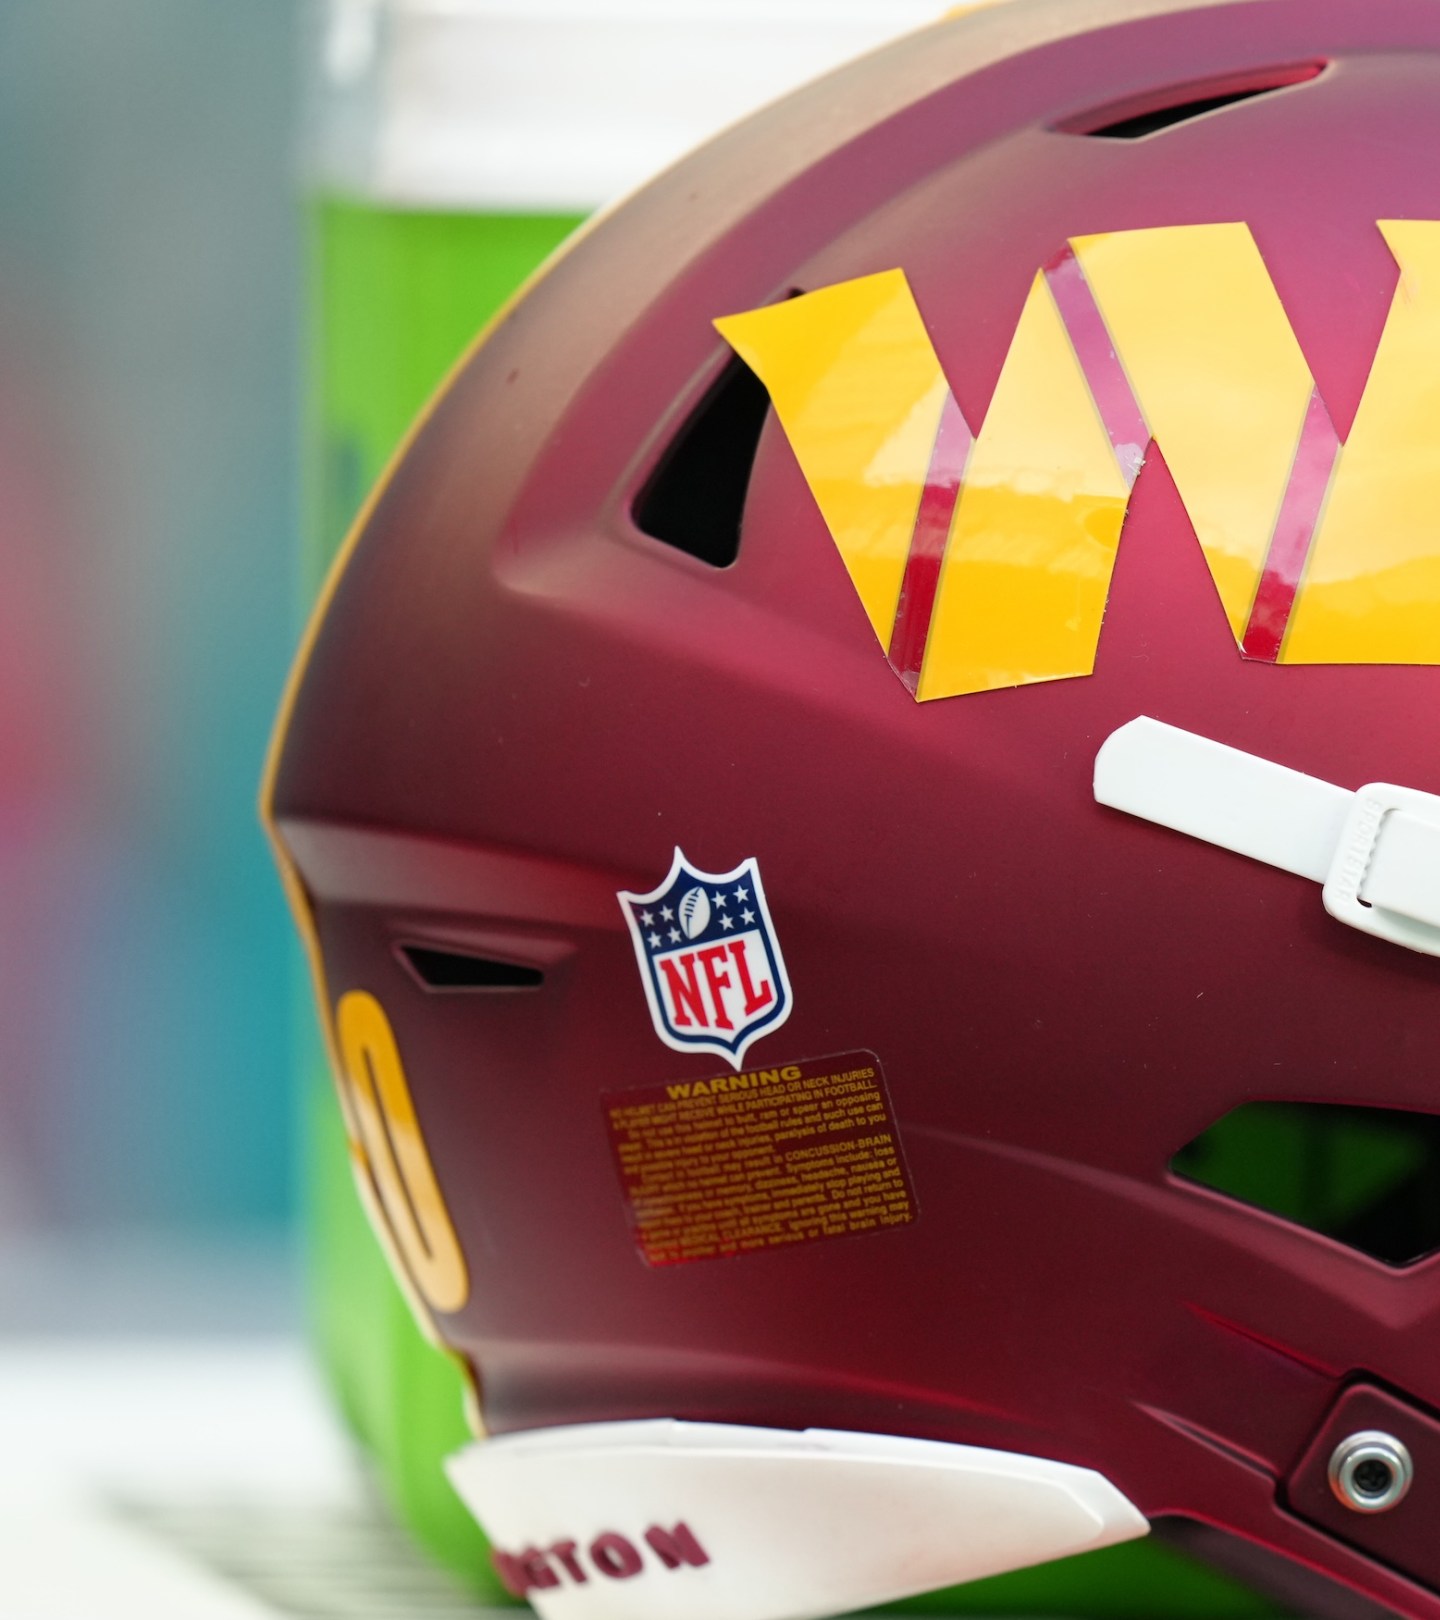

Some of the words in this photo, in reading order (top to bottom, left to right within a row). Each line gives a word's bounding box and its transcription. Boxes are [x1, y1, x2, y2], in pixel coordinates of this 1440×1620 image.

[659, 940, 773, 1031] NFL
[666, 1065, 802, 1100] WARNING
[745, 1090, 812, 1109] PARTICIPATING
[813, 1089, 823, 1097] IN
[824, 1079, 877, 1096] FOOTBALL.
[758, 1083, 785, 1096] HEAD
[786, 1081, 801, 1091] OR
[802, 1076, 829, 1088] NECK
[830, 1068, 874, 1083] INJURIES
[792, 1103, 819, 1115] spear
[821, 1100, 833, 1108] an
[835, 1090, 880, 1107] opposing
[780, 1116, 802, 1127] rules
[803, 1112, 821, 1123] and
[823, 1108, 845, 1119] such
[847, 1106, 864, 1114] use
[865, 1103, 882, 1111] can
[828, 1118, 854, 1130] death
[856, 1116, 866, 1124] to
[868, 1114, 886, 1125] you
[784, 1134, 891, 1160] CONCUSSION-BRAIN
[874, 1145, 894, 1156] loss
[831, 1188, 845, 1198] Do
[846, 1186, 862, 1195] not
[892, 1178, 903, 1187] to
[847, 1172, 881, 1186] playing
[882, 1167, 899, 1177] and
[863, 1196, 881, 1206] you
[883, 1189, 906, 1200] have
[889, 1201, 909, 1211] may
